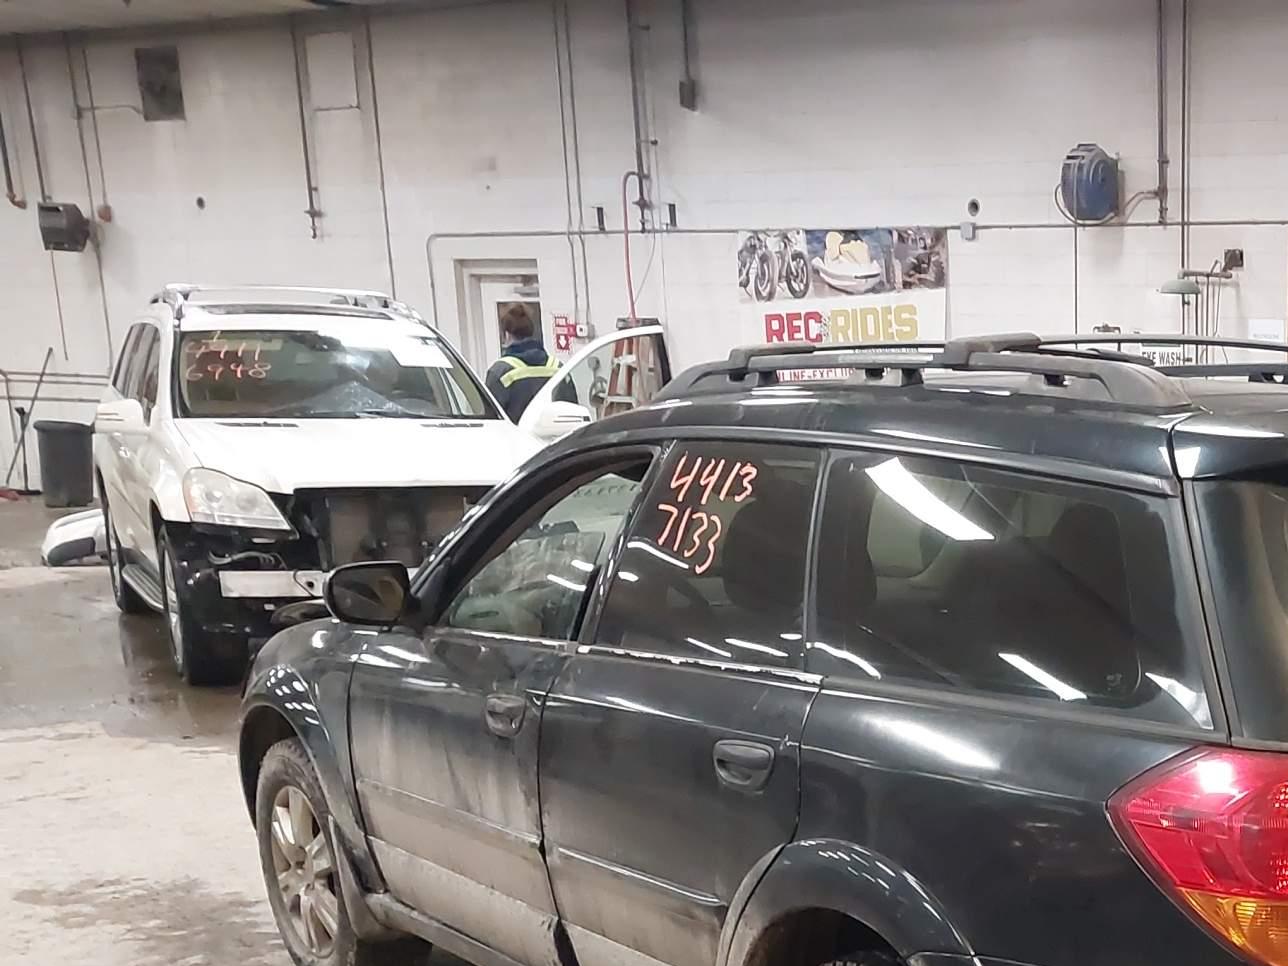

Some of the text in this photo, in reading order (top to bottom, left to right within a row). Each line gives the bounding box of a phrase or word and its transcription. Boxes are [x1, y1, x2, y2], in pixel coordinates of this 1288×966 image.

[765, 304, 918, 343] REC RIDES
[1159, 352, 1181, 365] WASH
[669, 450, 758, 505] 4413
[657, 503, 722, 574] 7133
